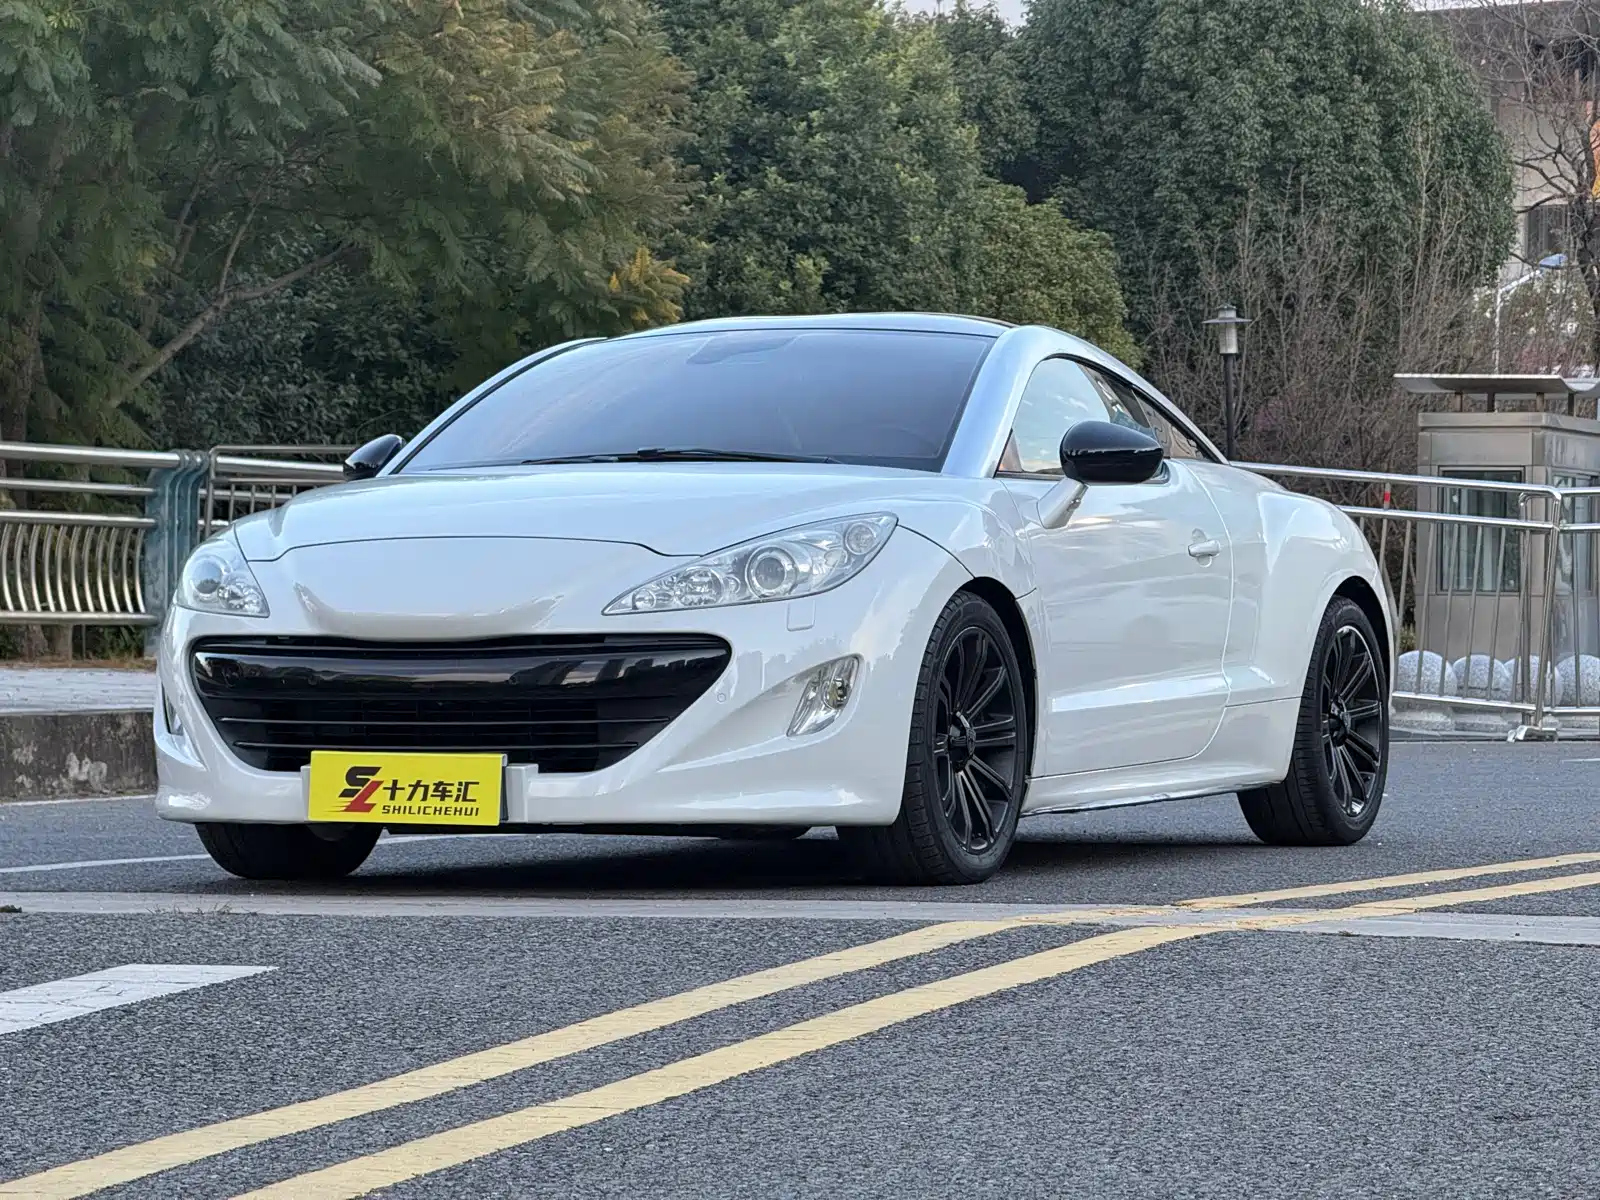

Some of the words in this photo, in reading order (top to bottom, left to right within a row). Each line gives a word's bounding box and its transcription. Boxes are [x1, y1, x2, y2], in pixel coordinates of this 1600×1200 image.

[382, 779, 480, 803] 十力车汇
[381, 804, 480, 817] SHILICHEHUI
